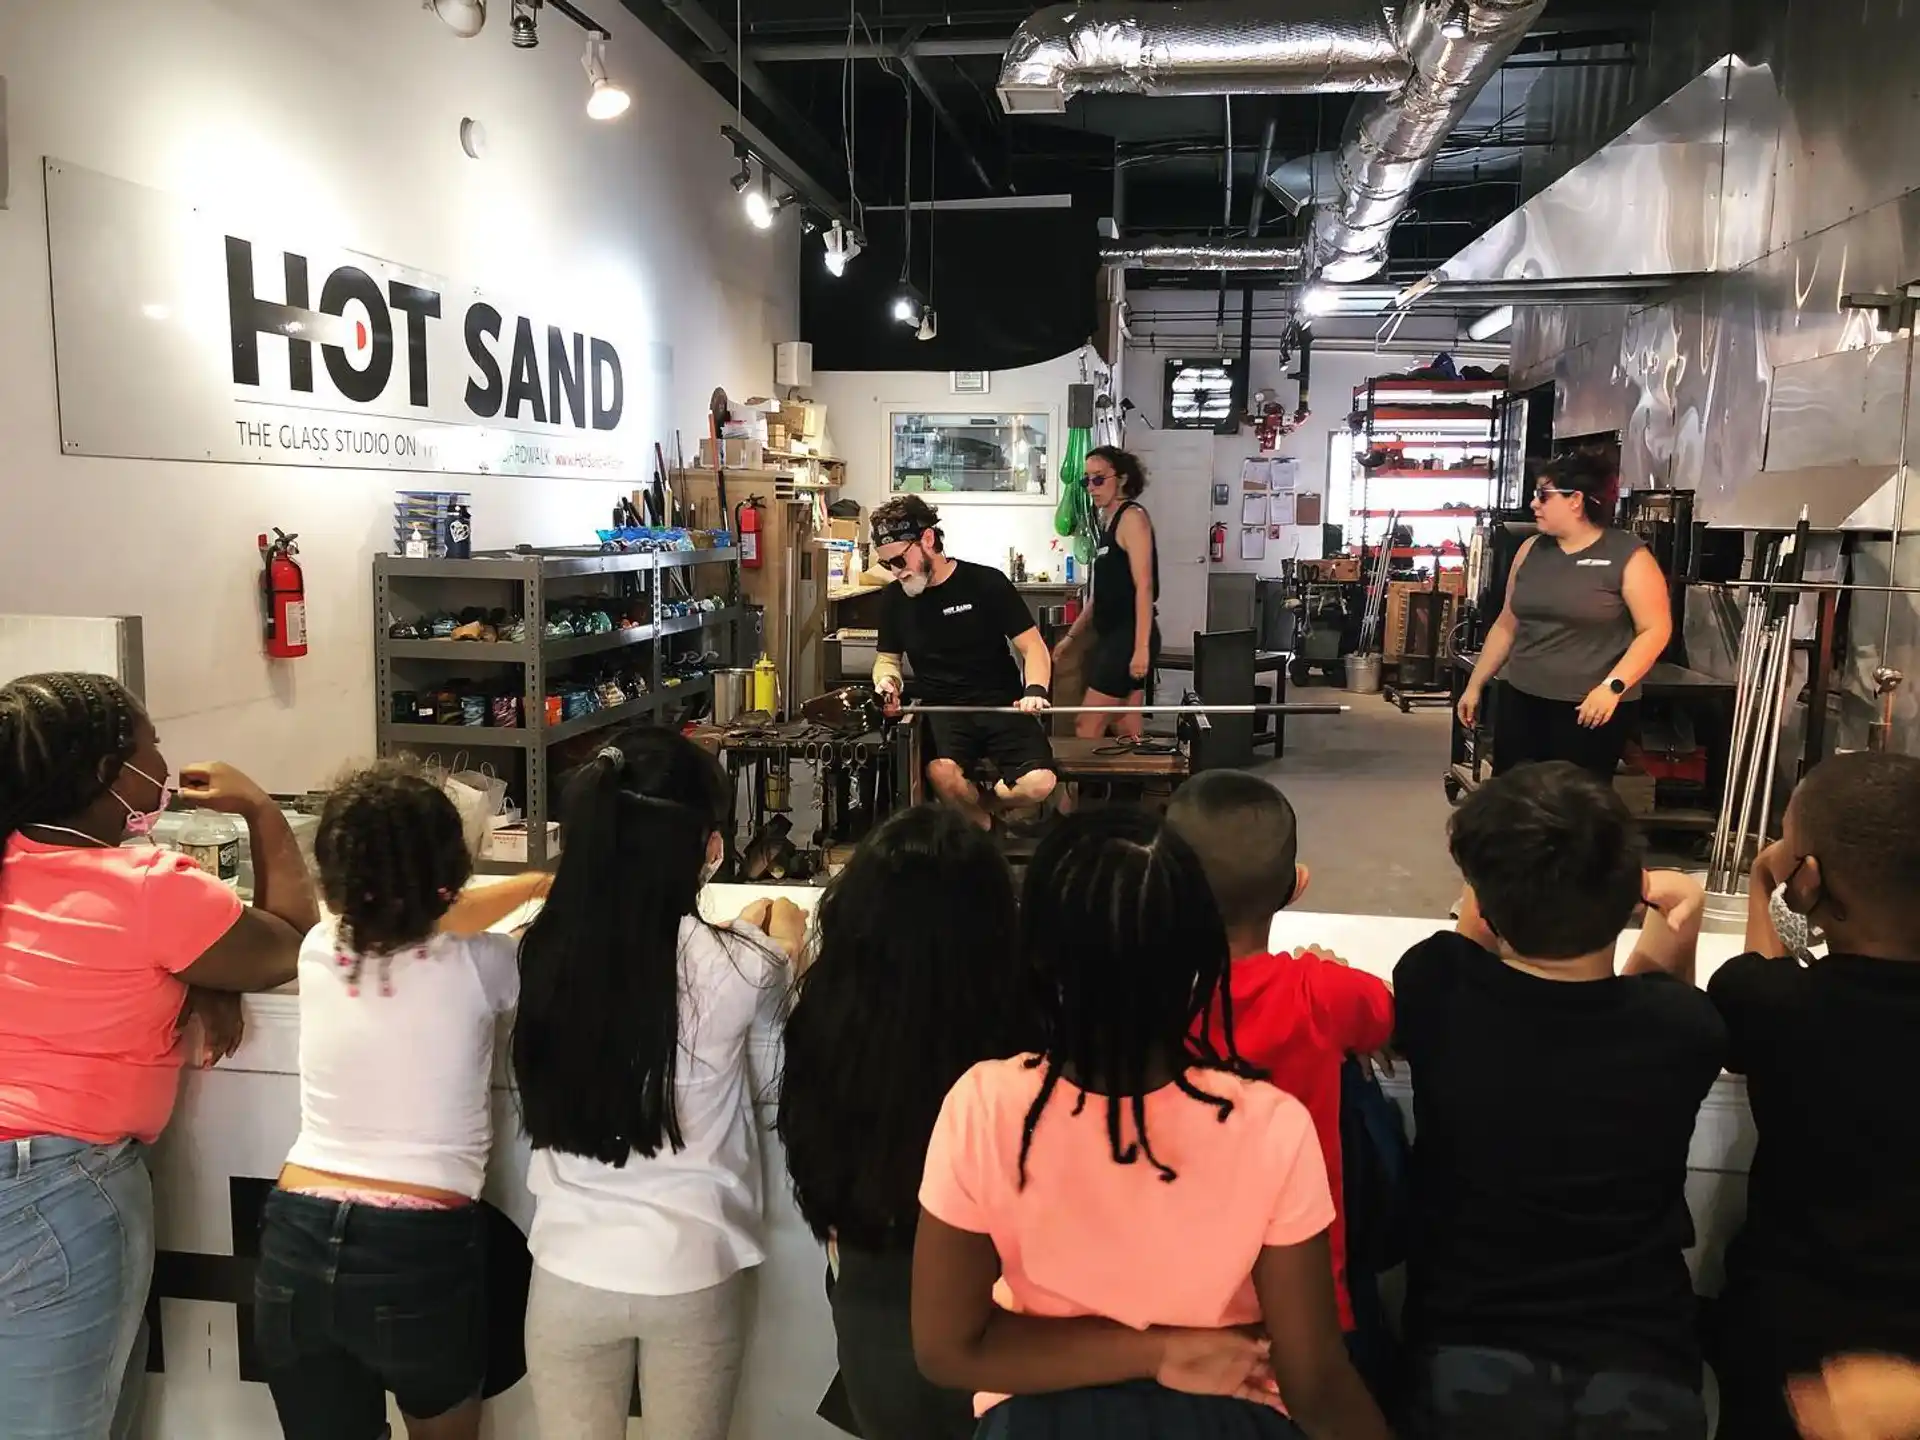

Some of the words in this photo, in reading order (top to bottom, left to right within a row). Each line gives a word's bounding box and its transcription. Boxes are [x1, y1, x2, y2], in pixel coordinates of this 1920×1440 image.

[225, 235, 441, 407] HOT
[463, 301, 623, 430] SAND
[236, 421, 271, 447] THE
[278, 425, 329, 451] GLASS
[335, 429, 389, 455] STUDIO
[394, 434, 416, 456] ON
